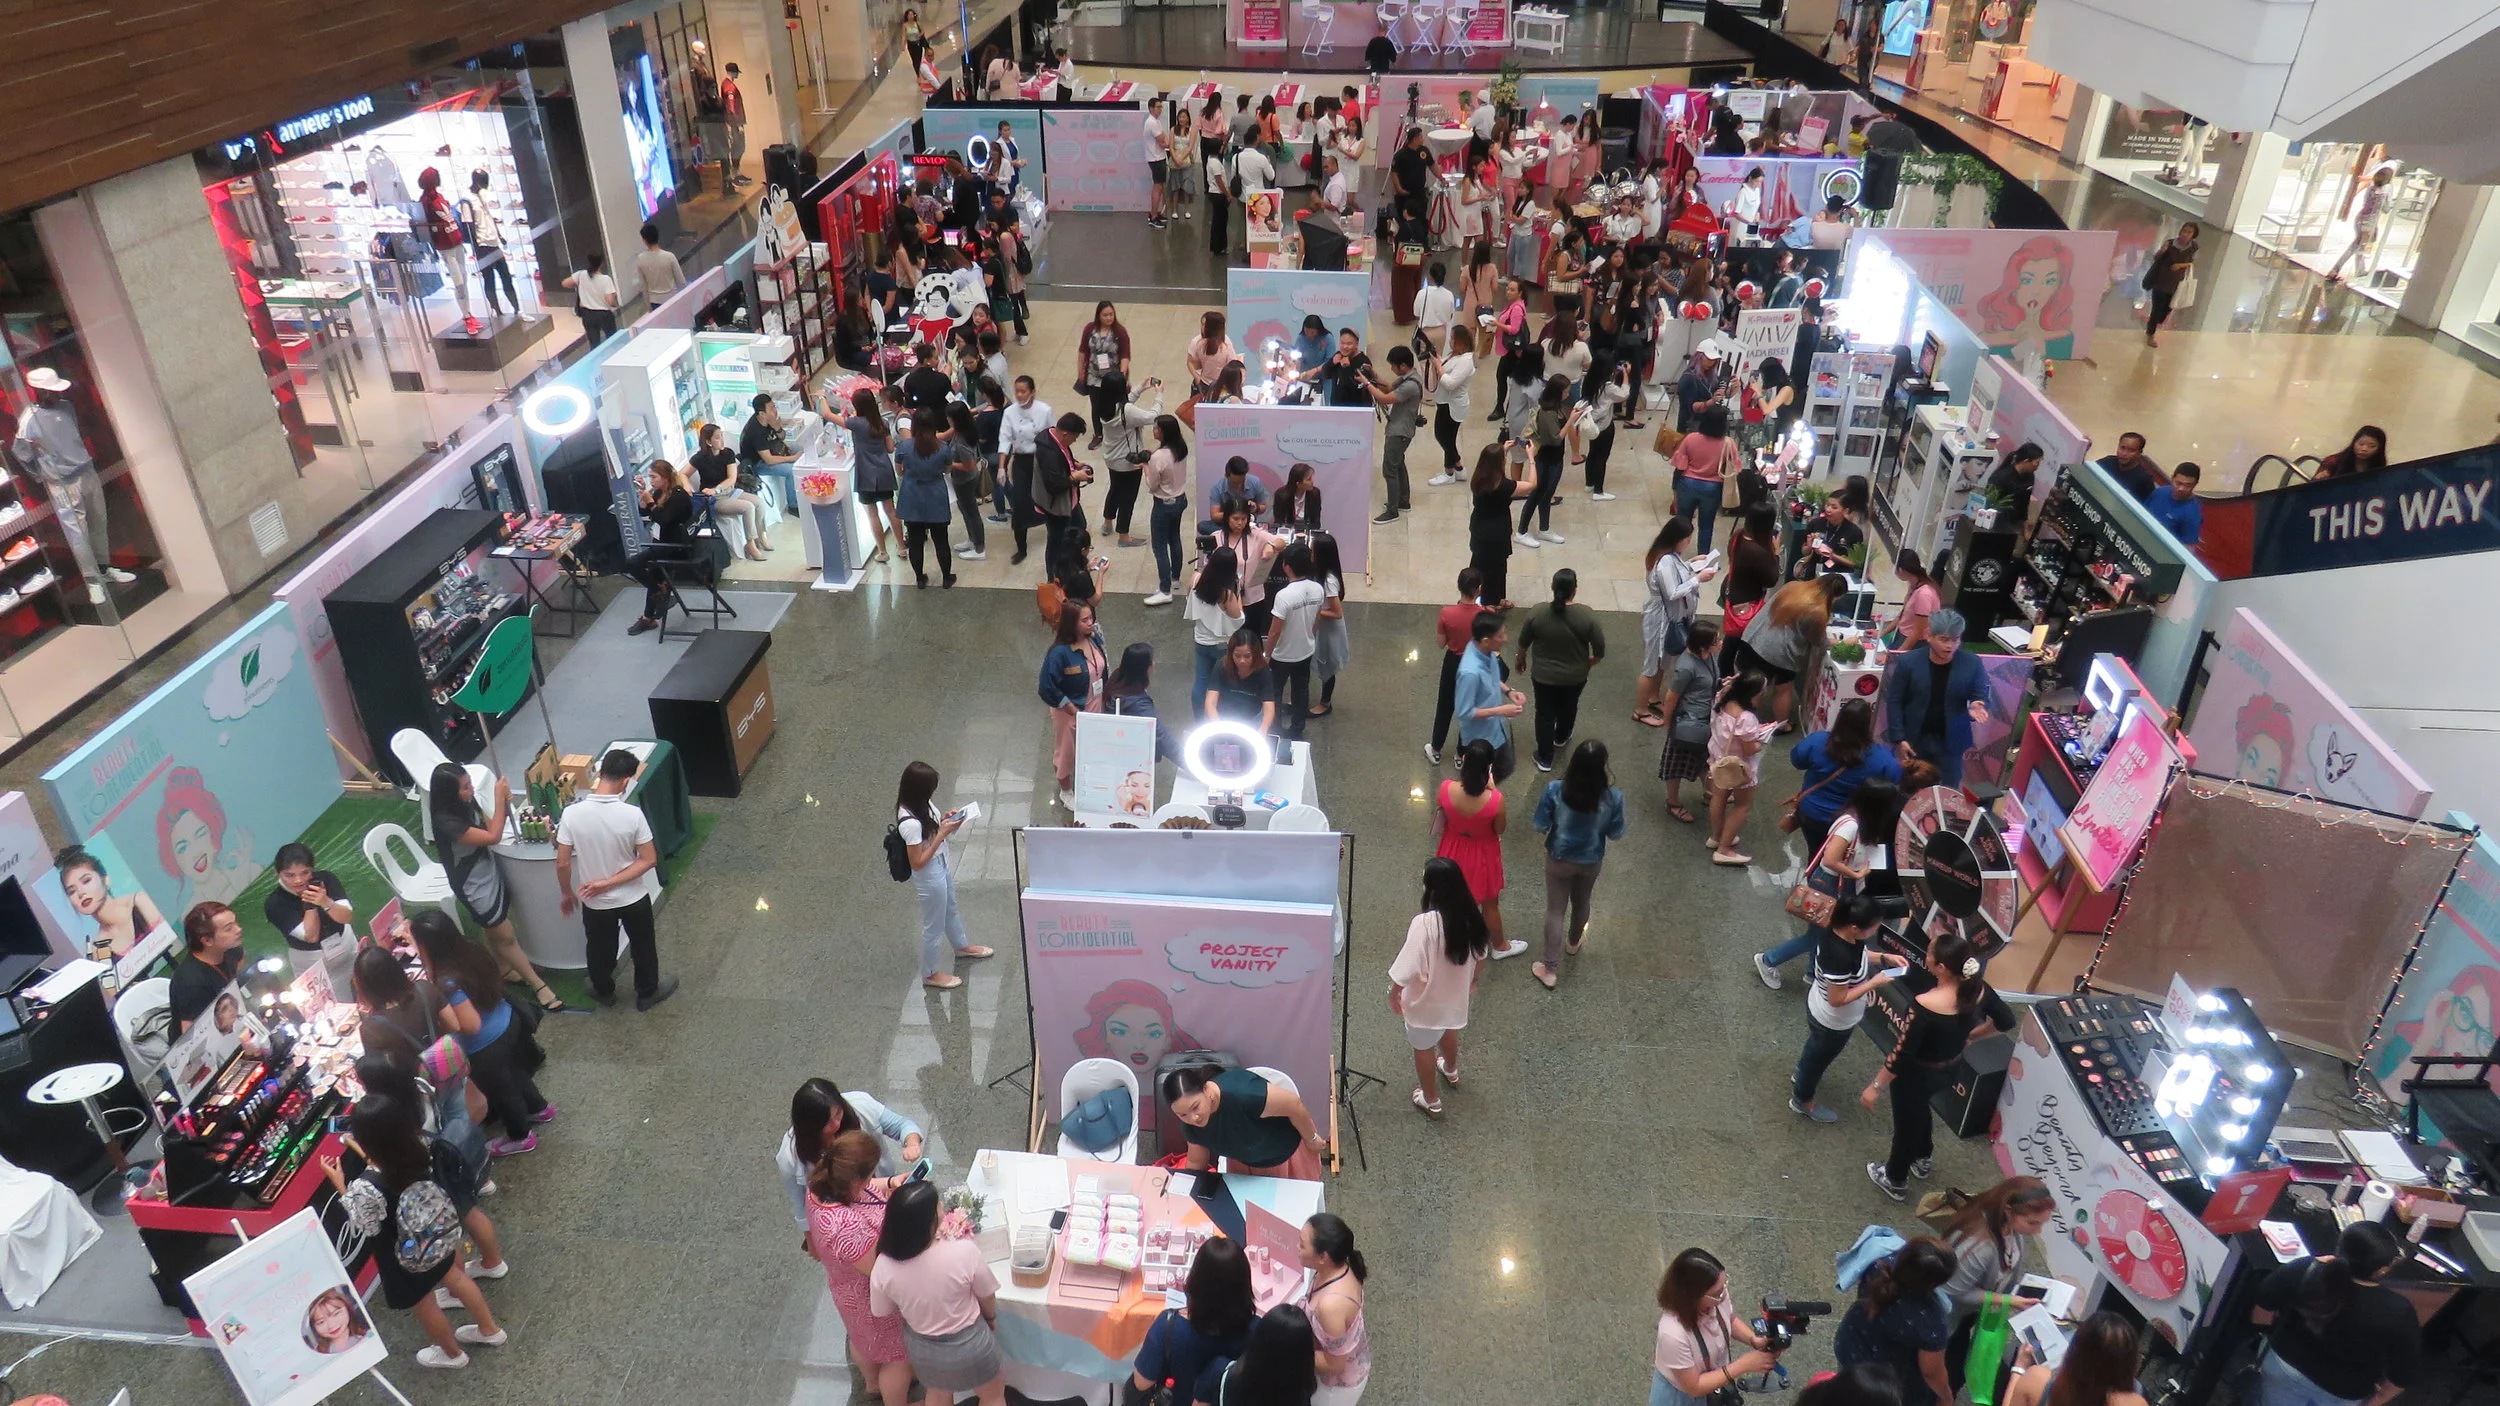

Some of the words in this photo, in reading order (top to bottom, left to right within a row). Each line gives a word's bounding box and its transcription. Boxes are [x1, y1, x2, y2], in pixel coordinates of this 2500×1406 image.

[913, 156, 948, 165] REVLON
[1320, 437, 1361, 446] COLLECTION
[483, 449, 509, 473] BYS
[2067, 487, 2086, 508] BODY
[2083, 502, 2102, 524] SHOP
[2308, 498, 2385, 543] THIS
[2399, 479, 2493, 532] WAY
[559, 531, 582, 554] BYS
[2102, 522, 2117, 542] THE
[2114, 538, 2135, 560] BODY
[2131, 554, 2152, 578] SHOP
[438, 546, 467, 576] BYS
[736, 691, 767, 739] BYS
[2119, 752, 2137, 776] WAS
[2127, 740, 2150, 769] WHEN
[2113, 766, 2129, 786] THE
[2124, 781, 2143, 806] LAST
[1060, 914, 1111, 930] BEAUTY
[1039, 931, 1138, 949] CONFIDENTIAL
[1200, 942, 1289, 958] PROJECT
[1210, 958, 1277, 972] VANITY
[2036, 1094, 2089, 1173] Beauty
[2027, 1120, 2082, 1206] Beyond
